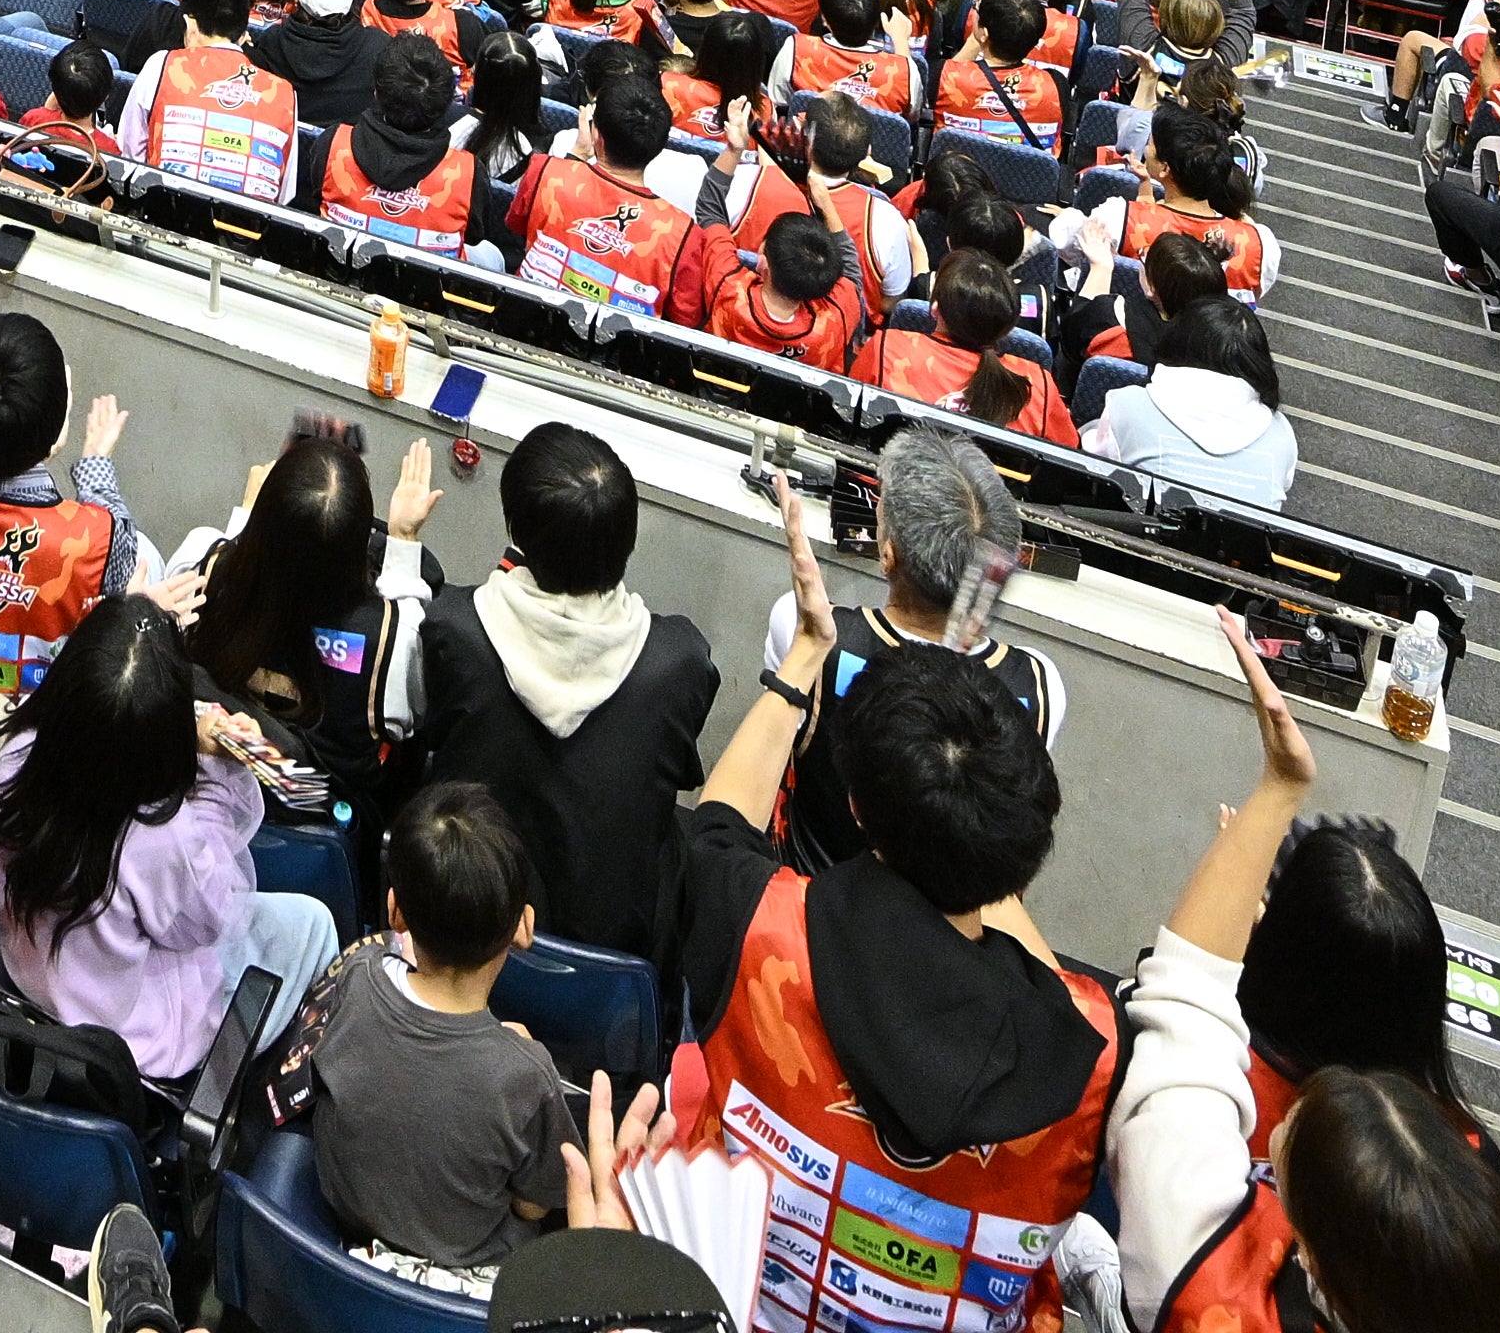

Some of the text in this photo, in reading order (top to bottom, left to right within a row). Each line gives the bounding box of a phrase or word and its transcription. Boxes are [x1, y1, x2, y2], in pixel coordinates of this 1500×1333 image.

[223, 135, 243, 147] OFA
[580, 279, 601, 296] OFA
[618, 297, 646, 313] mizuho
[728, 1101, 831, 1181] Amosys
[864, 1185, 948, 1229] HASHIMOTO
[885, 1240, 938, 1275] OFA
